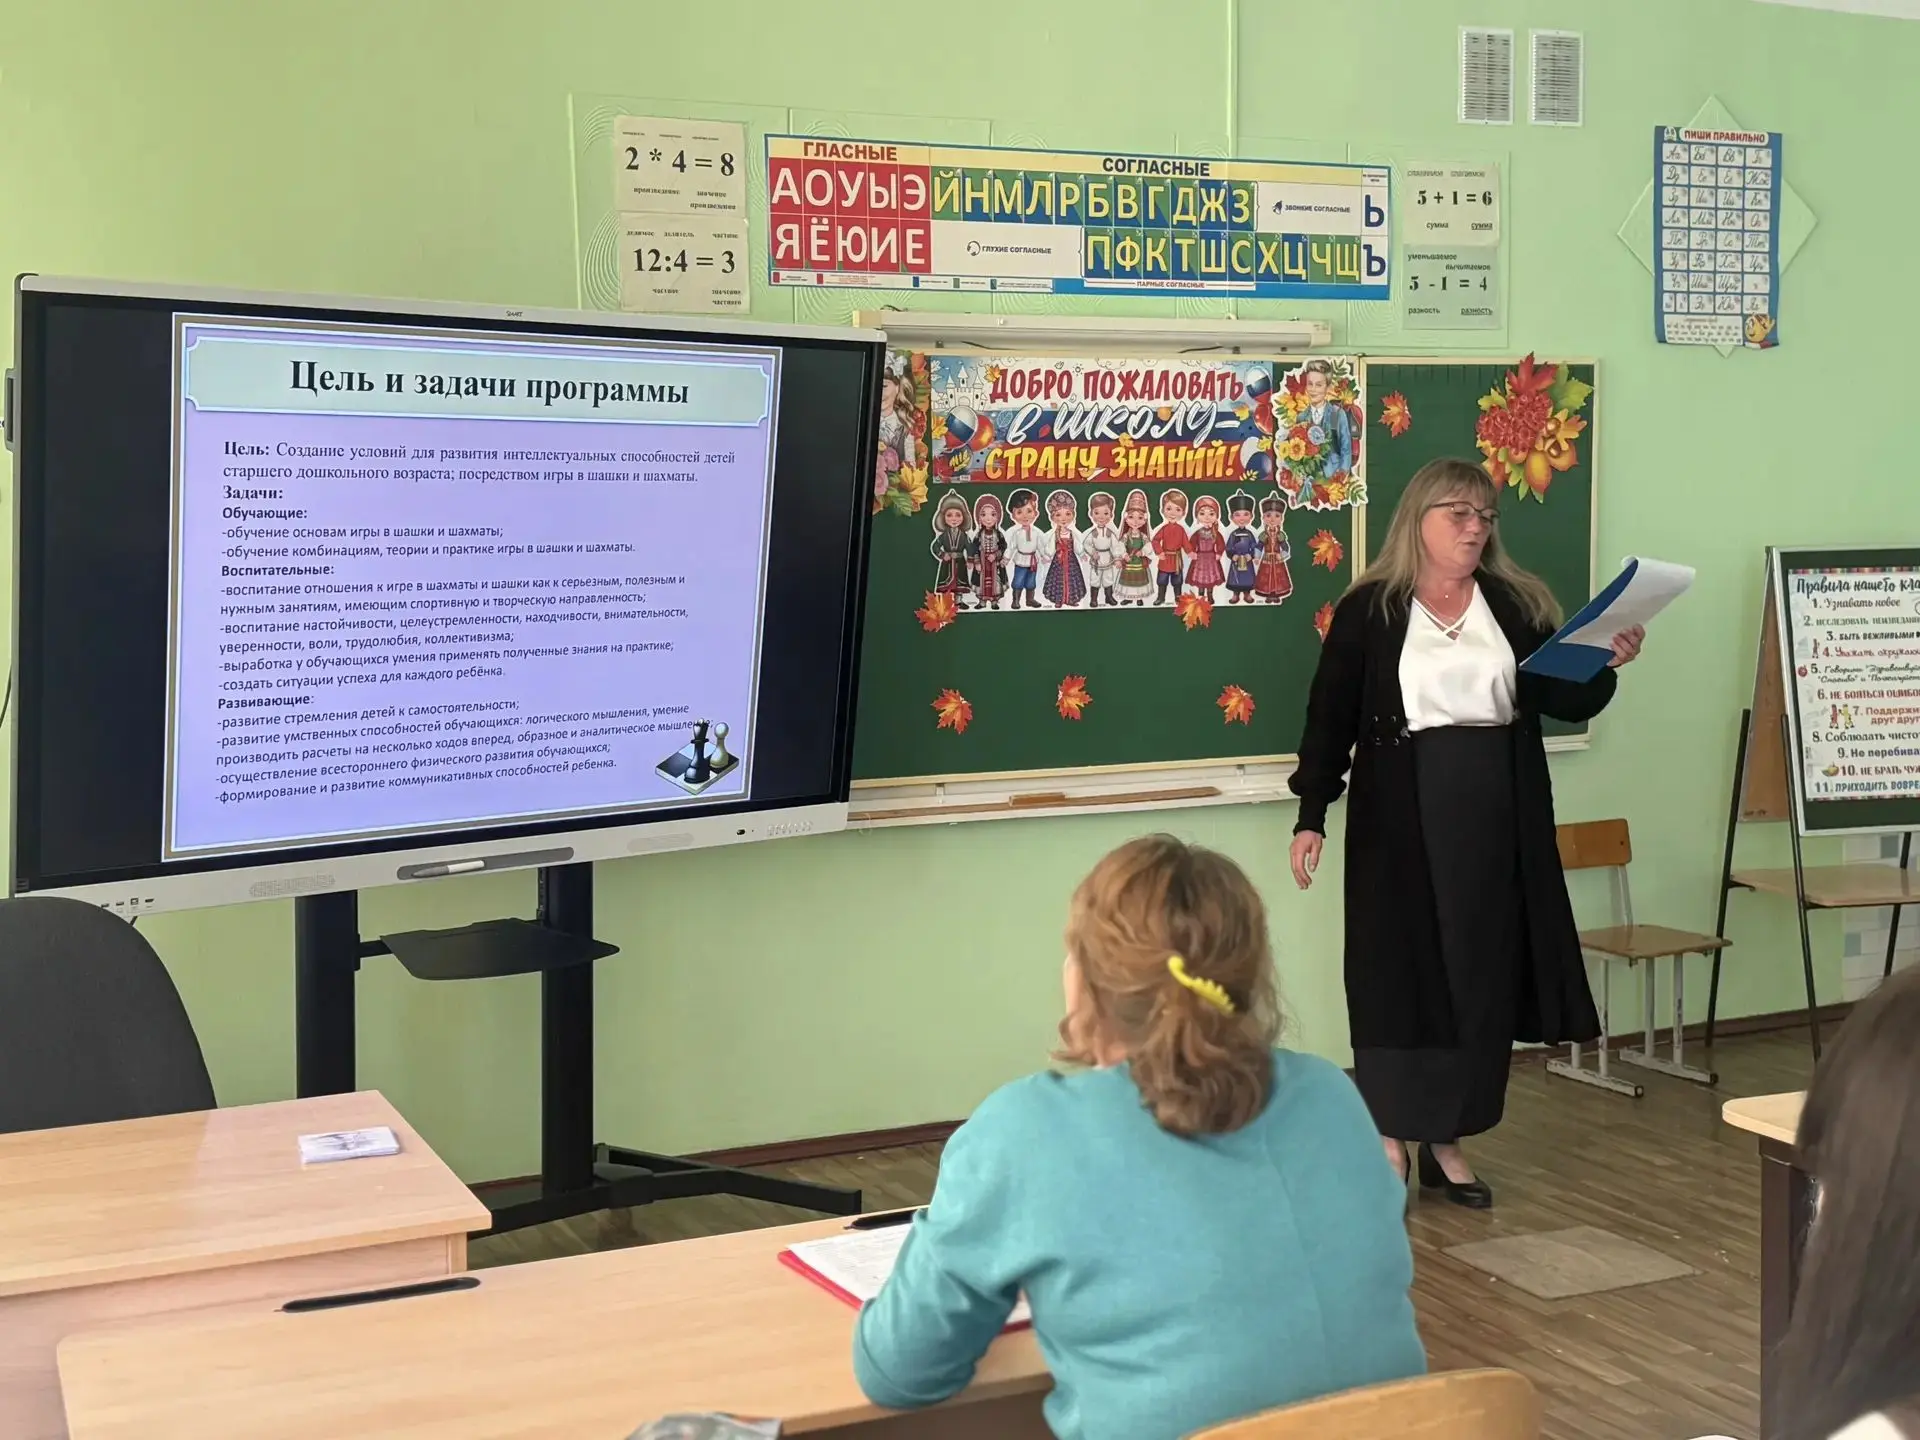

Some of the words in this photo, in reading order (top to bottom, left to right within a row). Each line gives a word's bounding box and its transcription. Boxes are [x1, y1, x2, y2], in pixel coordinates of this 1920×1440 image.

[1684, 130, 1711, 140] ПИШИ
[1713, 131, 1765, 143] ПРАВИЛЬНО
[803, 141, 897, 161] ГЛАСНЫЕ
[625, 147, 639, 170] 2
[672, 150, 687, 173] 4
[721, 153, 734, 176] 8
[1102, 158, 1210, 176] СОГЛАСНЫЕ
[1418, 190, 1427, 205] 5
[1452, 191, 1458, 205] 1
[1482, 191, 1492, 206] 6
[1285, 204, 1312, 212] ЗВОНКИЕ
[1426, 222, 1449, 230] сумма
[1471, 222, 1493, 230] сумма
[1010, 246, 1051, 254] СОГЛАСНЫЕ
[634, 248, 688, 272] 12:4
[721, 250, 735, 273] 3
[1409, 276, 1419, 290] 5
[1441, 276, 1447, 290] 1
[1479, 276, 1487, 291] 4
[290, 361, 374, 397] Цель
[386, 374, 404, 392] и
[414, 375, 516, 399] задачи
[526, 380, 688, 408] программы
[989, 368, 1073, 403] ДОБРО
[1084, 368, 1244, 403] ПОЖАЛОВАТЬ
[225, 442, 269, 457] Цель:
[277, 443, 344, 458] Создание
[350, 445, 406, 460] условий
[411, 449, 434, 459] для
[441, 450, 497, 462] развития
[504, 451, 616, 461] интеллектуальных
[621, 450, 699, 462] способностей
[704, 452, 734, 463] детей
[985, 446, 1101, 480] СТРАНУ
[1109, 440, 1241, 480] ЗНАНИЙ!
[224, 467, 292, 481] старшего
[296, 468, 389, 479] дошкольного
[394, 470, 454, 482] возраста;
[459, 471, 539, 483] посредством
[544, 472, 573, 483] игры
[577, 472, 584, 480] в
[588, 472, 629, 480] шашки
[632, 473, 640, 481] и
[644, 473, 697, 481] шахматы.
[223, 485, 283, 500] Задачи:
[223, 506, 307, 521] Обучающие:
[222, 566, 336, 576] Воспитательные:
[1797, 577, 1850, 599] Правила
[1854, 577, 1896, 592] нашего
[221, 605, 275, 617] нужным
[279, 603, 341, 613] занятиям,
[345, 601, 407, 612] имеющим
[411, 599, 479, 611] спортивную
[482, 599, 490, 607] и
[493, 596, 556, 608] творческую
[559, 594, 645, 606] направленность;
[1812, 598, 1822, 609] 1.
[1824, 597, 1873, 611] Узнавать
[1875, 596, 1900, 607] новое
[220, 623, 299, 633] -воспитание
[304, 618, 396, 630] настойчивости,
[400, 616, 522, 629] целеустремленности,
[526, 613, 600, 623] находчивости,
[605, 609, 688, 619] внимательности,
[1803, 615, 1814, 626] 2.
[1827, 631, 1837, 641] 3.
[1839, 632, 1860, 640] БЫТЬ
[1863, 631, 1914, 640] ВЕЖЛИВЫМИ
[220, 641, 305, 655] уверенности,
[309, 640, 341, 650] воли,
[345, 634, 421, 650] трудолюбия,
[425, 633, 513, 644] коллективизма;
[1823, 647, 1833, 657] 4.
[1811, 663, 1821, 674] 5.
[1817, 688, 1828, 700] 6.
[1830, 691, 1841, 699] НЕ
[1844, 690, 1884, 698] БОЯТЬСЯ
[218, 696, 314, 709] Развивающие:
[218, 716, 281, 730] -развитие
[284, 711, 357, 725] стремления
[361, 706, 395, 720] детей
[398, 708, 405, 716] к
[409, 702, 519, 715] самостоятельности;
[1853, 706, 1863, 716] 7.
[217, 734, 280, 749] -развитие
[284, 729, 357, 744] умственных
[361, 720, 441, 736] способностей
[445, 717, 522, 731] обучающихся:
[526, 713, 589, 724] логического
[592, 709, 649, 719] мышления,
[653, 706, 689, 717] умение
[1871, 716, 1895, 725] друг
[217, 752, 298, 767] производить
[302, 748, 351, 761] расчеты
[355, 746, 368, 754] на
[373, 741, 432, 753] несколько
[435, 738, 468, 749] ходов
[472, 735, 514, 747] вперед,
[518, 731, 568, 743] образное
[570, 730, 578, 738] и
[580, 724, 655, 737] аналитическое
[657, 719, 714, 732] мышлее;
[1812, 731, 1823, 742] 8.
[1825, 732, 1885, 742] Соблюдать
[1888, 732, 1920, 740] чисто
[1837, 747, 1848, 759] 9.
[1851, 749, 1865, 757] Не
[216, 768, 317, 785] -осуществление
[321, 761, 408, 775] всестороннего
[411, 755, 482, 770] физического
[485, 750, 534, 764] развития
[537, 744, 610, 758] обучающихся;
[1842, 765, 1858, 776] 10.
[1861, 767, 1873, 775] НЕ
[1875, 766, 1902, 775] БРАТЬ
[216, 786, 316, 804] -формирование
[332, 780, 385, 794] развитие
[389, 771, 493, 786] коммуникативных
[496, 761, 568, 777] способностей
[572, 759, 616, 772] ребенка.
[1815, 782, 1833, 793] 11.
[1835, 782, 1888, 792] ПРИХОДИТЬ
[1891, 780, 1920, 790] ВОВРЕ
